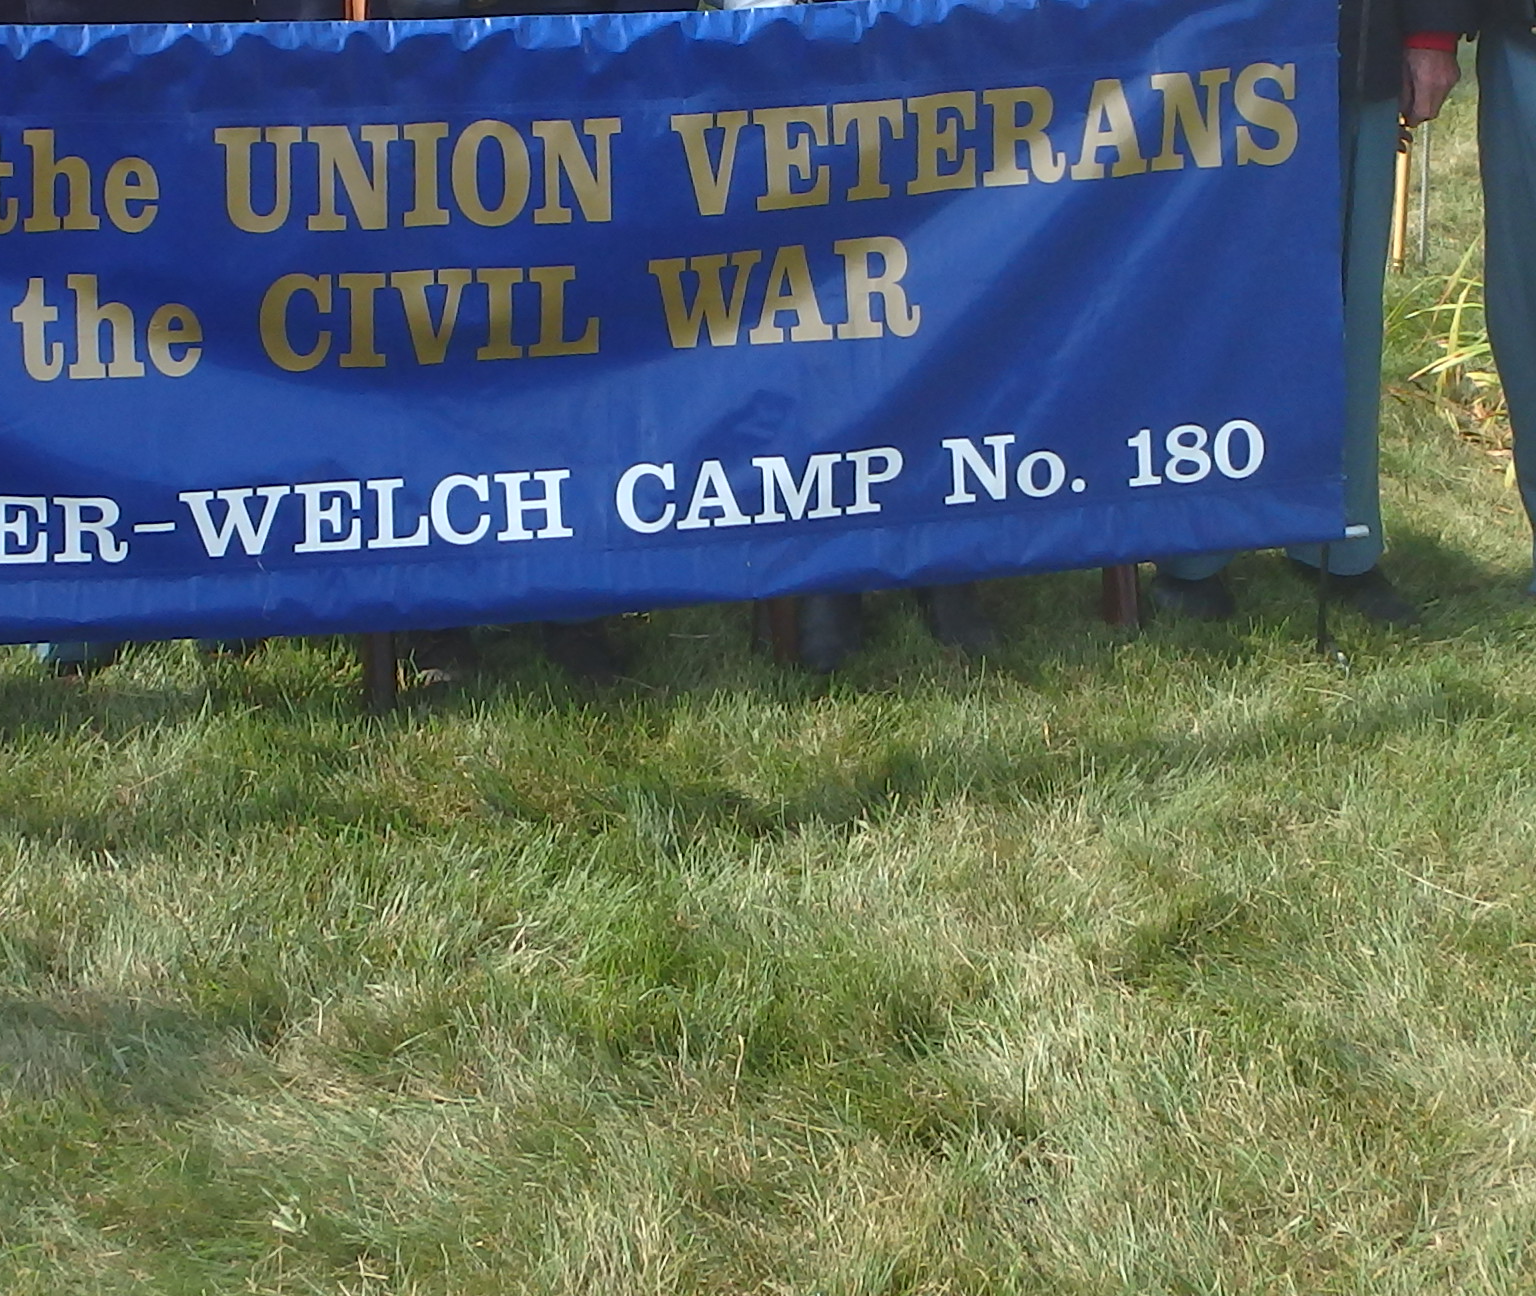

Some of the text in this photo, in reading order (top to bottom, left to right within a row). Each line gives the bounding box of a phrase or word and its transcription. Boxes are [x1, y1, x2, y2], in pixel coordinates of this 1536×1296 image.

[214, 117, 622, 233] UNION
[671, 62, 1298, 216] VETERANS
[12, 273, 204, 381] the
[259, 265, 600, 373] CIVIL
[648, 235, 921, 349] WAR
[615, 446, 904, 535] CAMP
[942, 434, 1087, 506] No.
[1126, 419, 1266, 488] 180
